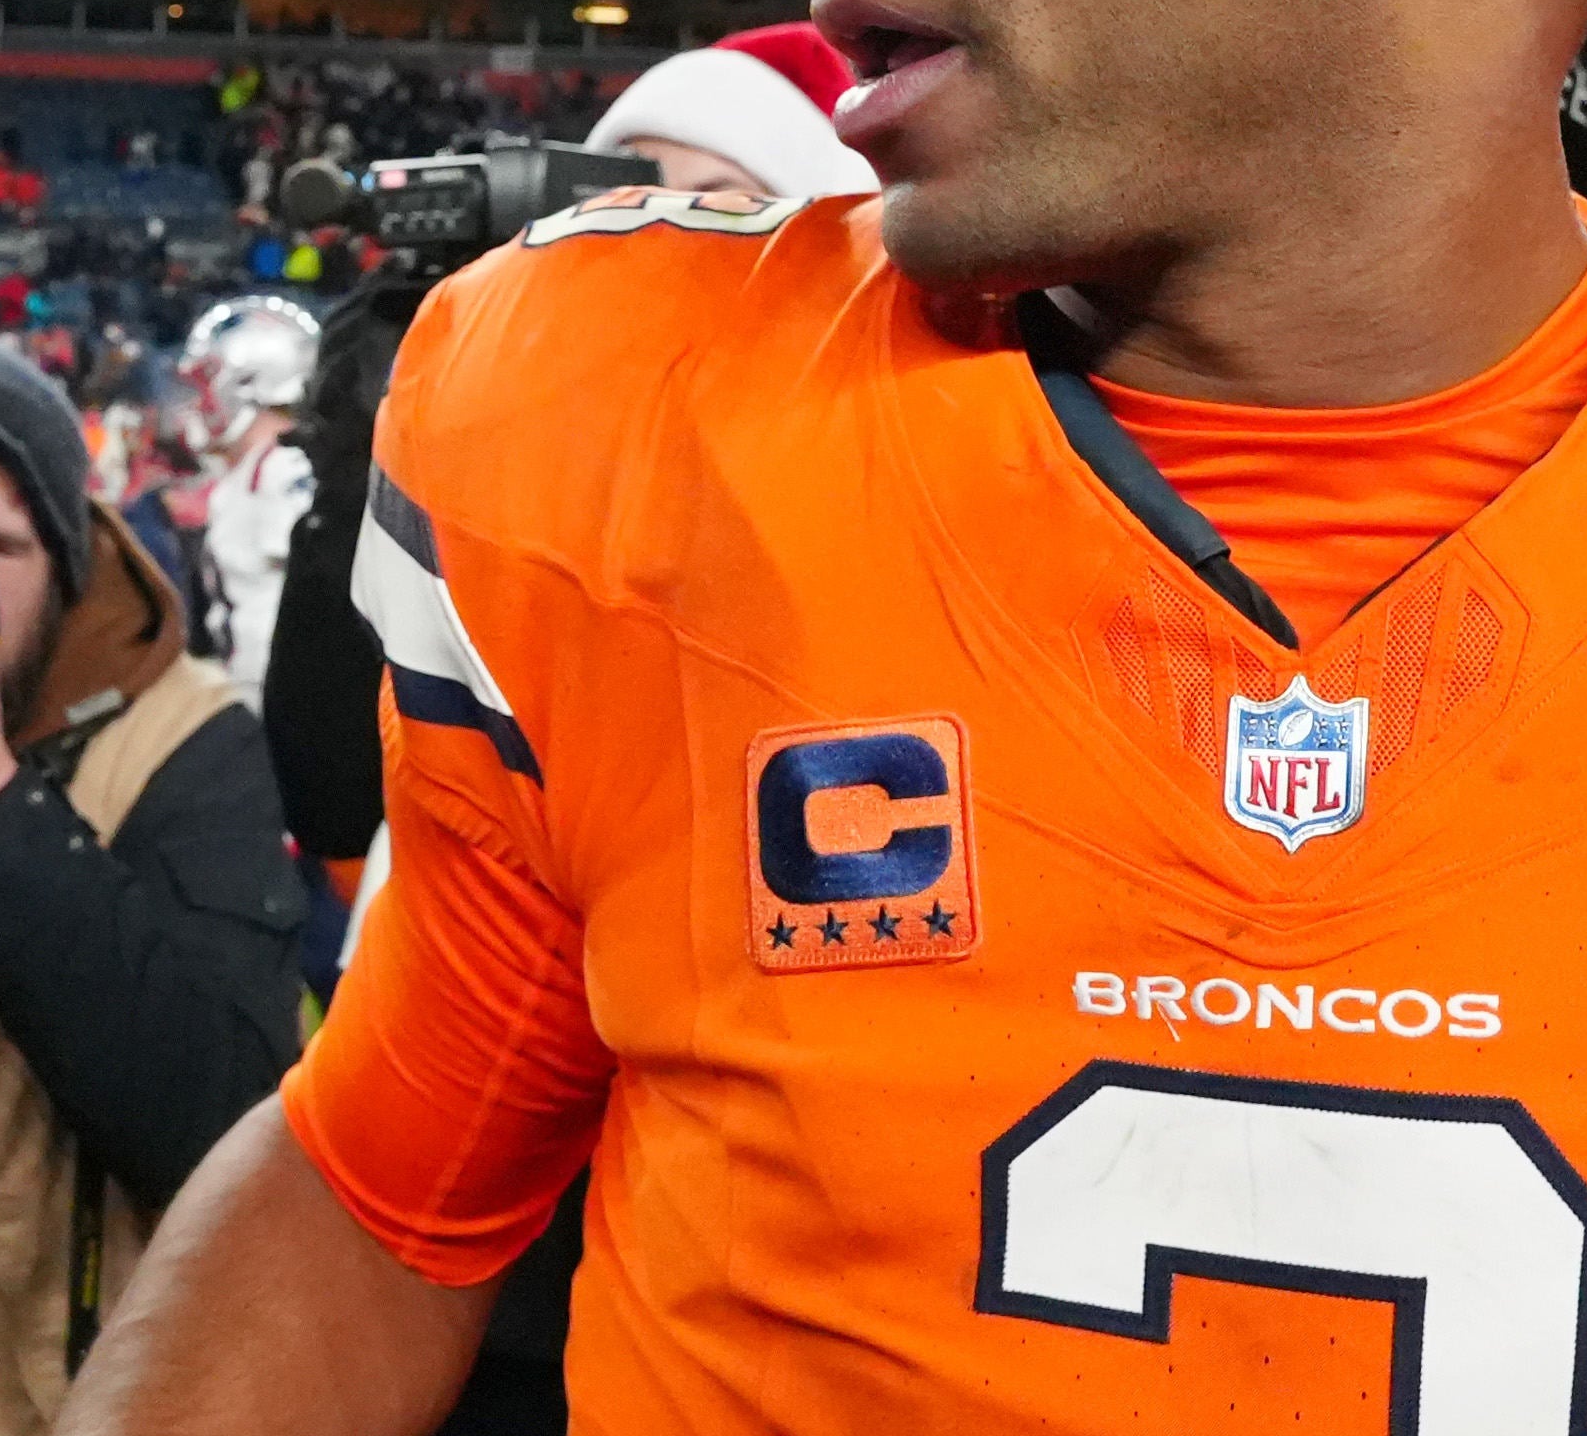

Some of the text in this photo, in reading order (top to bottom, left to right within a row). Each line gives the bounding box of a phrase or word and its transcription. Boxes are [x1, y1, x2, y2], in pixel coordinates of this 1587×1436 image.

[757, 732, 953, 905] C
[1245, 753, 1344, 818] NFL
[1072, 970, 1503, 1040] BRONCOS
